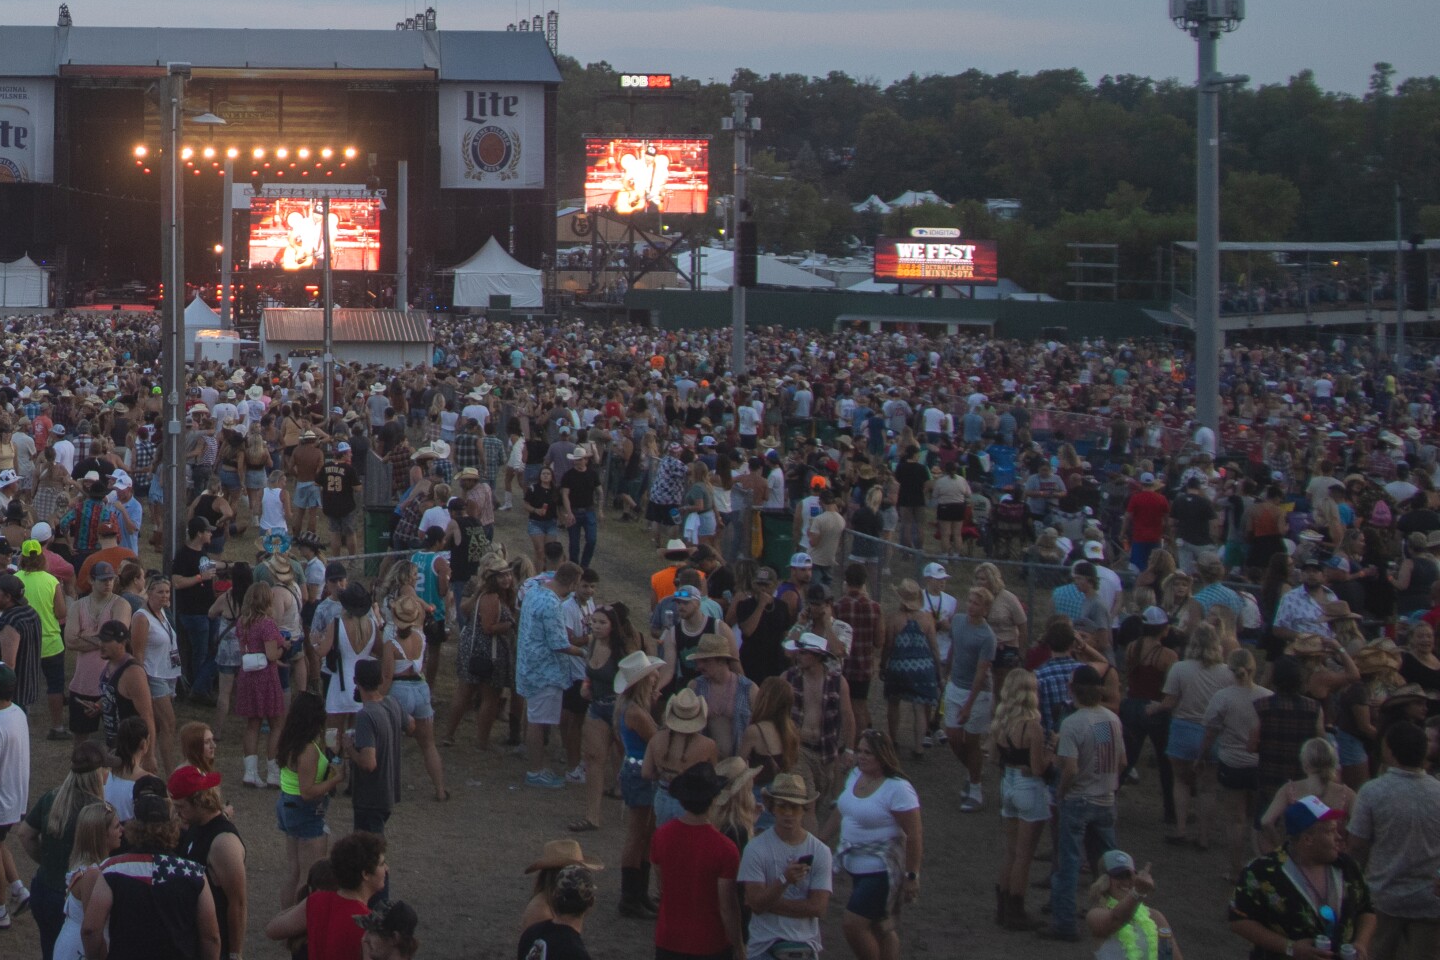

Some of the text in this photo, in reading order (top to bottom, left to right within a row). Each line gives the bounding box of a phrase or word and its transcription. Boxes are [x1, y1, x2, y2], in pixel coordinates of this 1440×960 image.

[463, 90, 519, 125] Lite
[896, 243, 976, 259] WE FEST
[328, 475, 342, 491] 23
